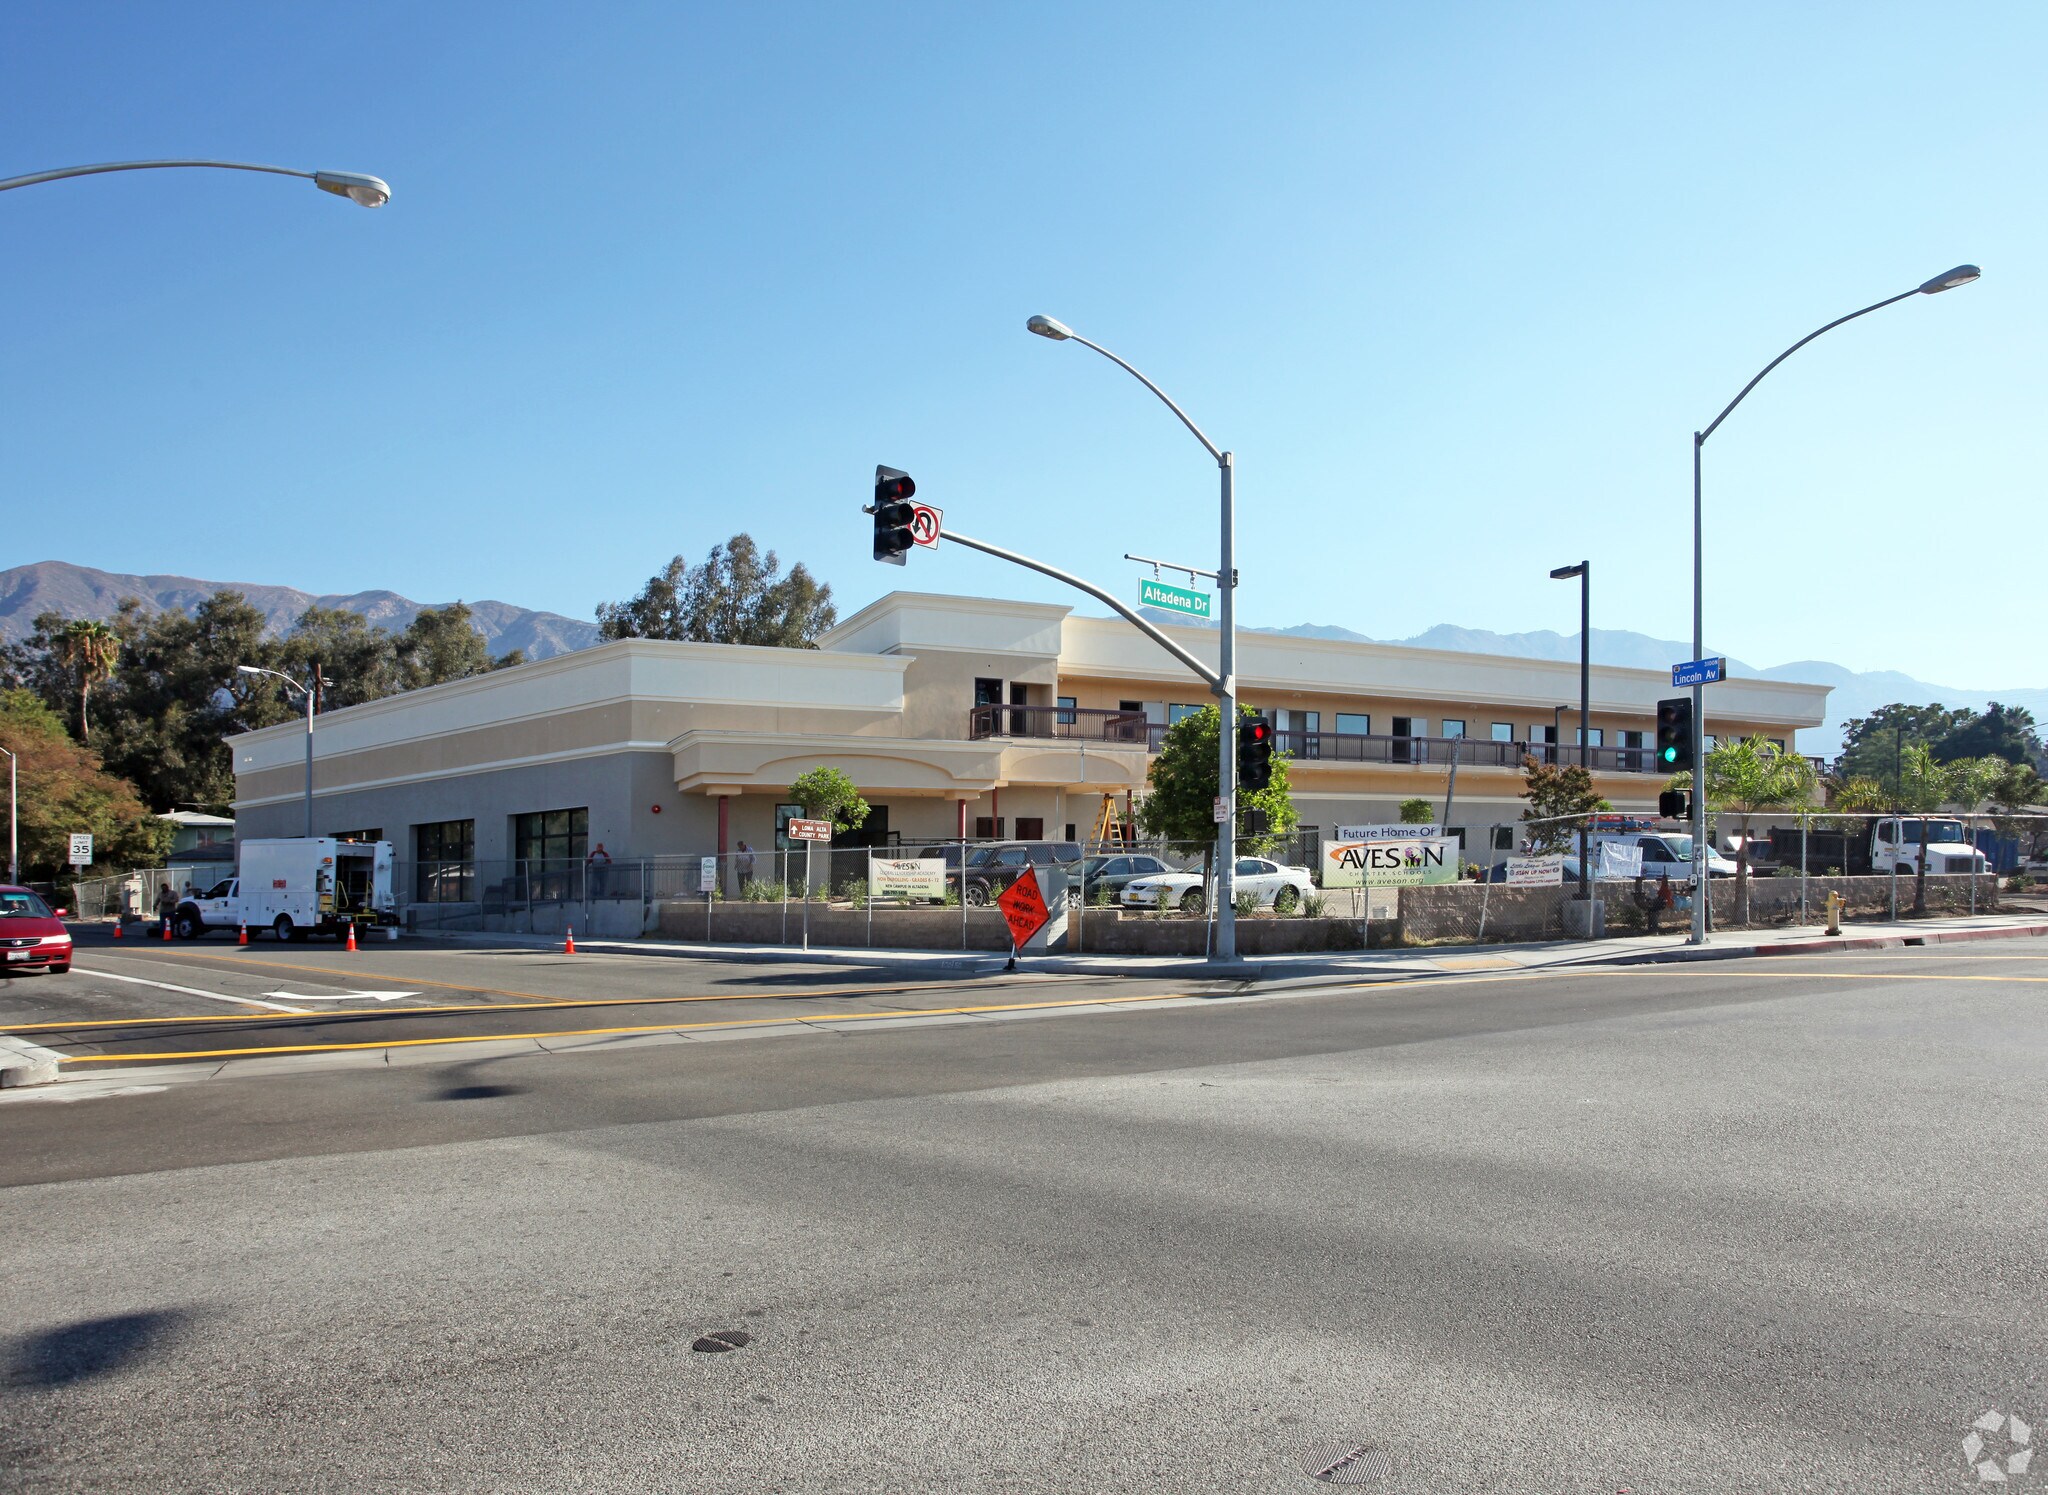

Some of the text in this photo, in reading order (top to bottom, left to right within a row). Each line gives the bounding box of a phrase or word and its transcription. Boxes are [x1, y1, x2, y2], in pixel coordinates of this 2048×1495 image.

[1144, 586, 1207, 611] Altadena Dr
[1675, 669, 1716, 684] Lincoln Av
[1343, 826, 1436, 838] Future Home Of
[73, 845, 90, 854] 35
[1016, 884, 1038, 900] ROAD
[1012, 900, 1035, 912] WORK
[1008, 914, 1034, 930] AHEAD
